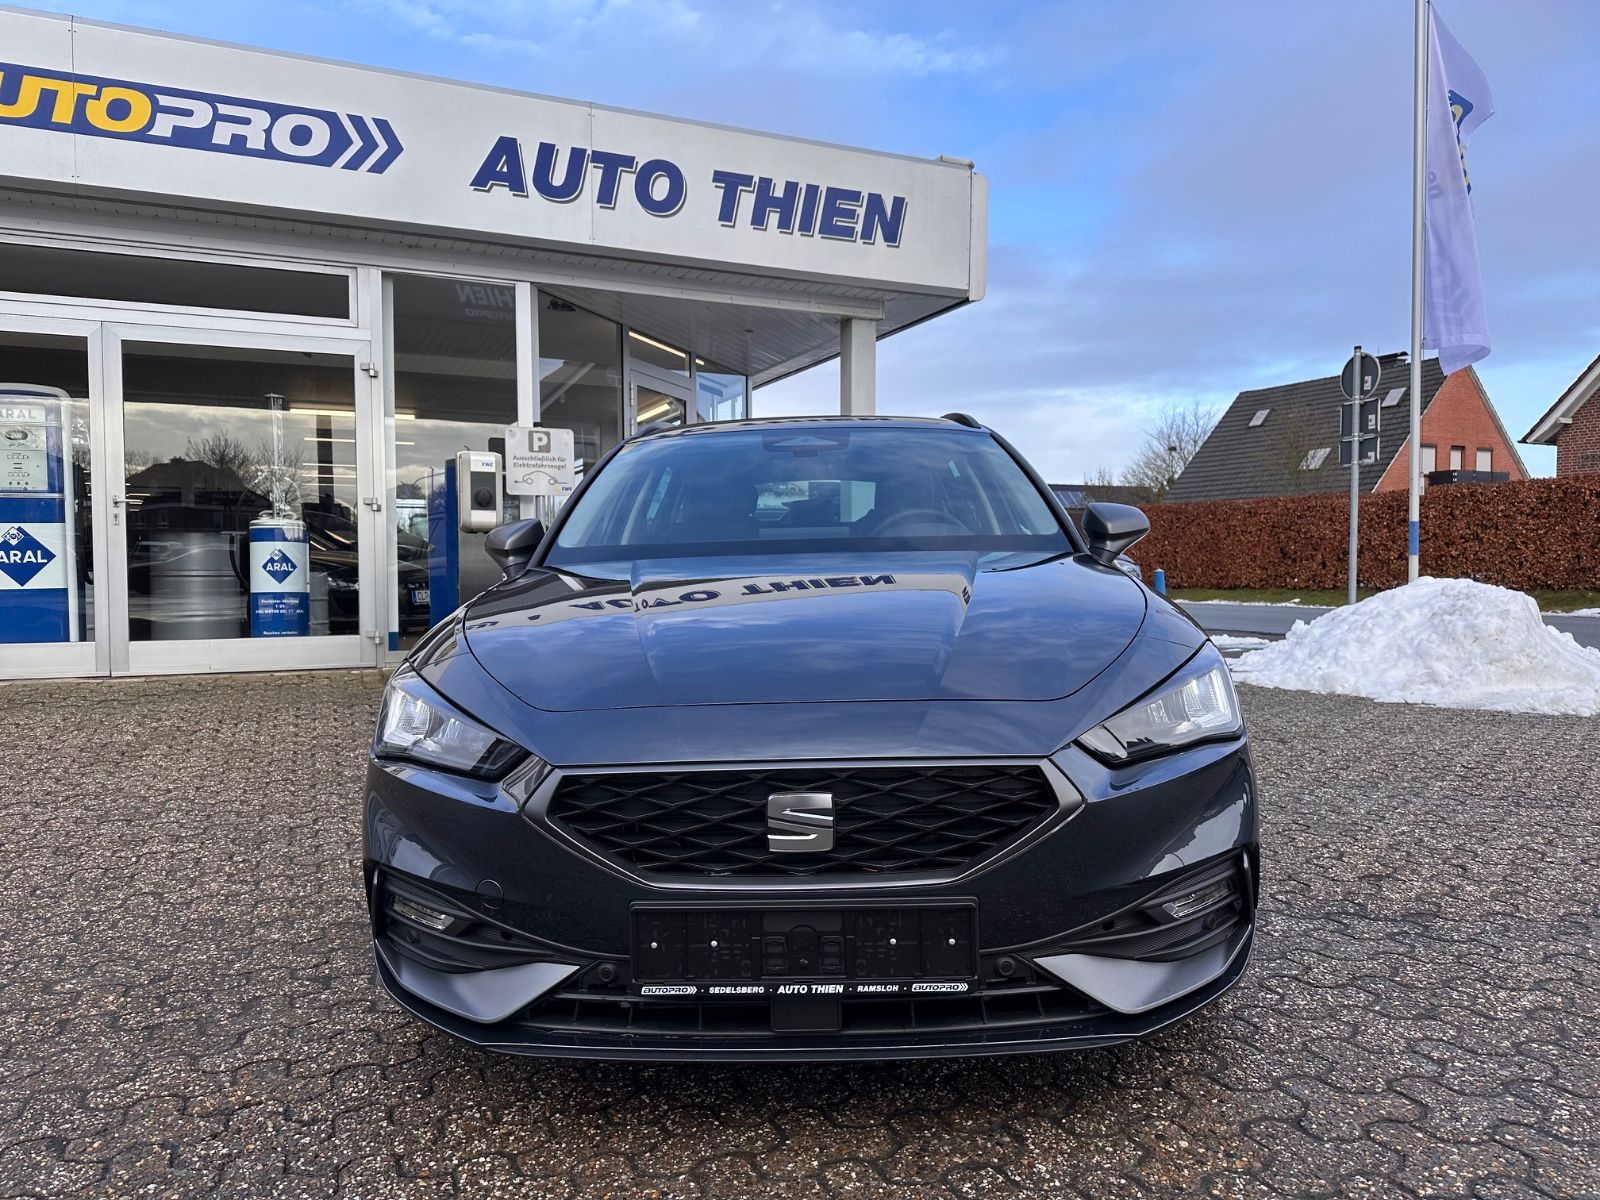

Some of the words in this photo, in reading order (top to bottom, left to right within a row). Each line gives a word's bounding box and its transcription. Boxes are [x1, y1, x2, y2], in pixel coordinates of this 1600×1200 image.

[469, 136, 687, 217] AUTO
[712, 169, 908, 248] THIEN
[532, 432, 549, 452] P
[512, 455, 557, 463] Ausschließlich
[513, 461, 568, 471] Elektrofahrzeuge!
[0, 550, 48, 564] ARAL
[266, 562, 294, 571] ARAL
[708, 986, 765, 994] SEDELSBERG
[777, 984, 808, 994] AUTO
[811, 984, 844, 994] THIEN
[857, 984, 899, 993] RAMSLOH
